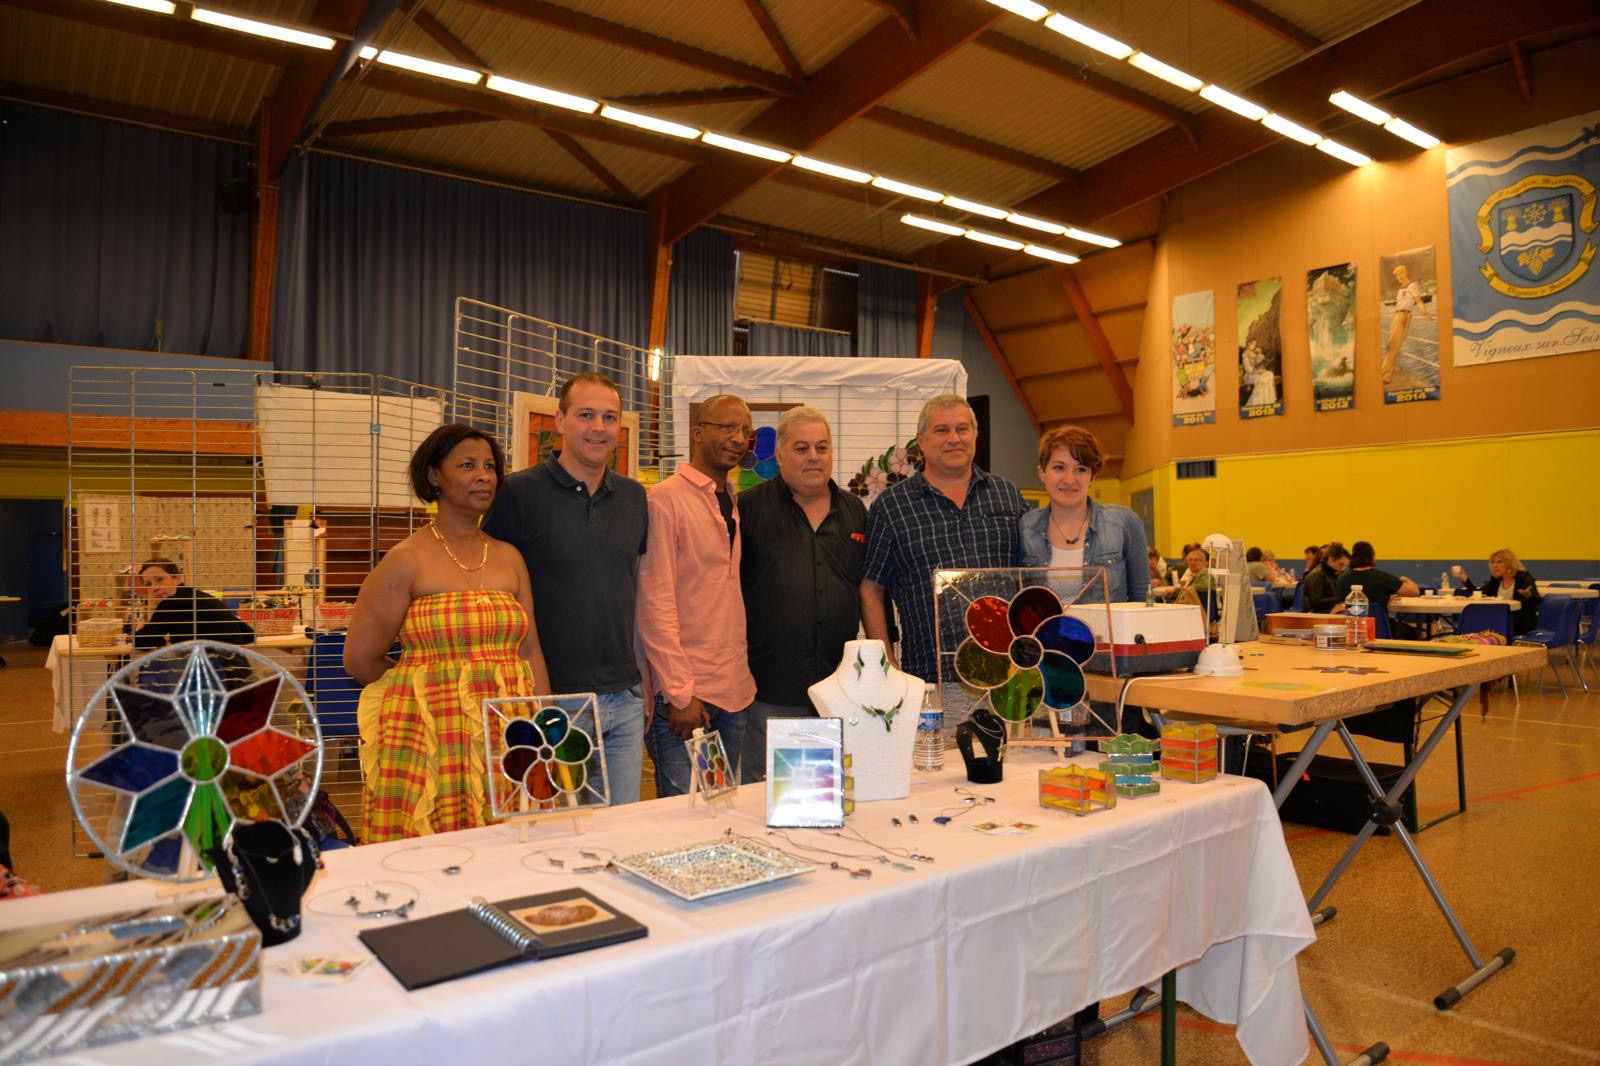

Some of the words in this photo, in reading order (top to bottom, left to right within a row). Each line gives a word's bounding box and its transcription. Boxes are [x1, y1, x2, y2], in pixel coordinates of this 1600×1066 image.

[1396, 392, 1426, 402] 2014
[1320, 400, 1348, 410] 2013
[1248, 408, 1275, 417] 2012
[1183, 416, 1205, 424] 2011
